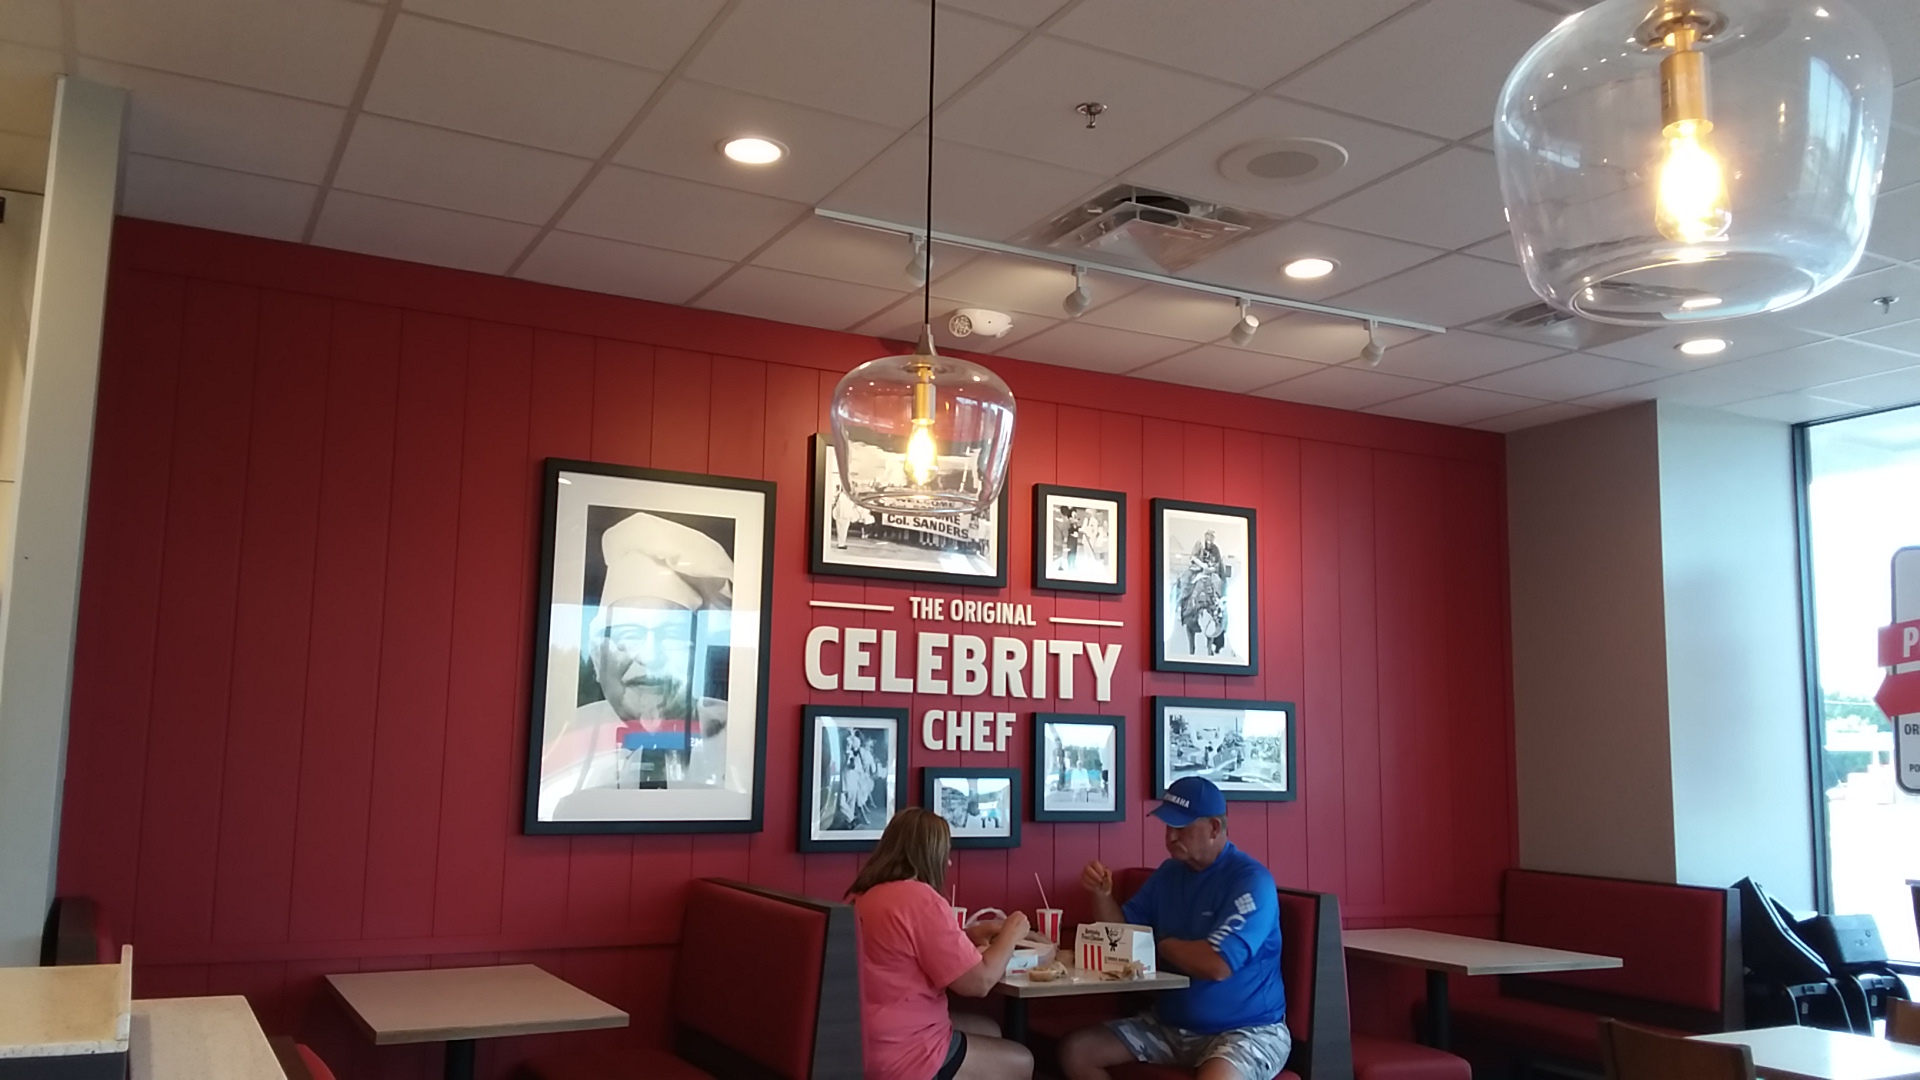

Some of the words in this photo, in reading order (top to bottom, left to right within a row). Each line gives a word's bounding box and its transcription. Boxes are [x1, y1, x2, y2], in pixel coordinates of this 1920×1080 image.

[887, 513, 910, 526] Col.
[912, 516, 969, 539] SANDERS
[909, 597, 944, 621] THE
[949, 599, 1037, 626] ORIGINAL
[804, 625, 1123, 702] CELEBRITY
[922, 709, 1017, 752] CHEF
